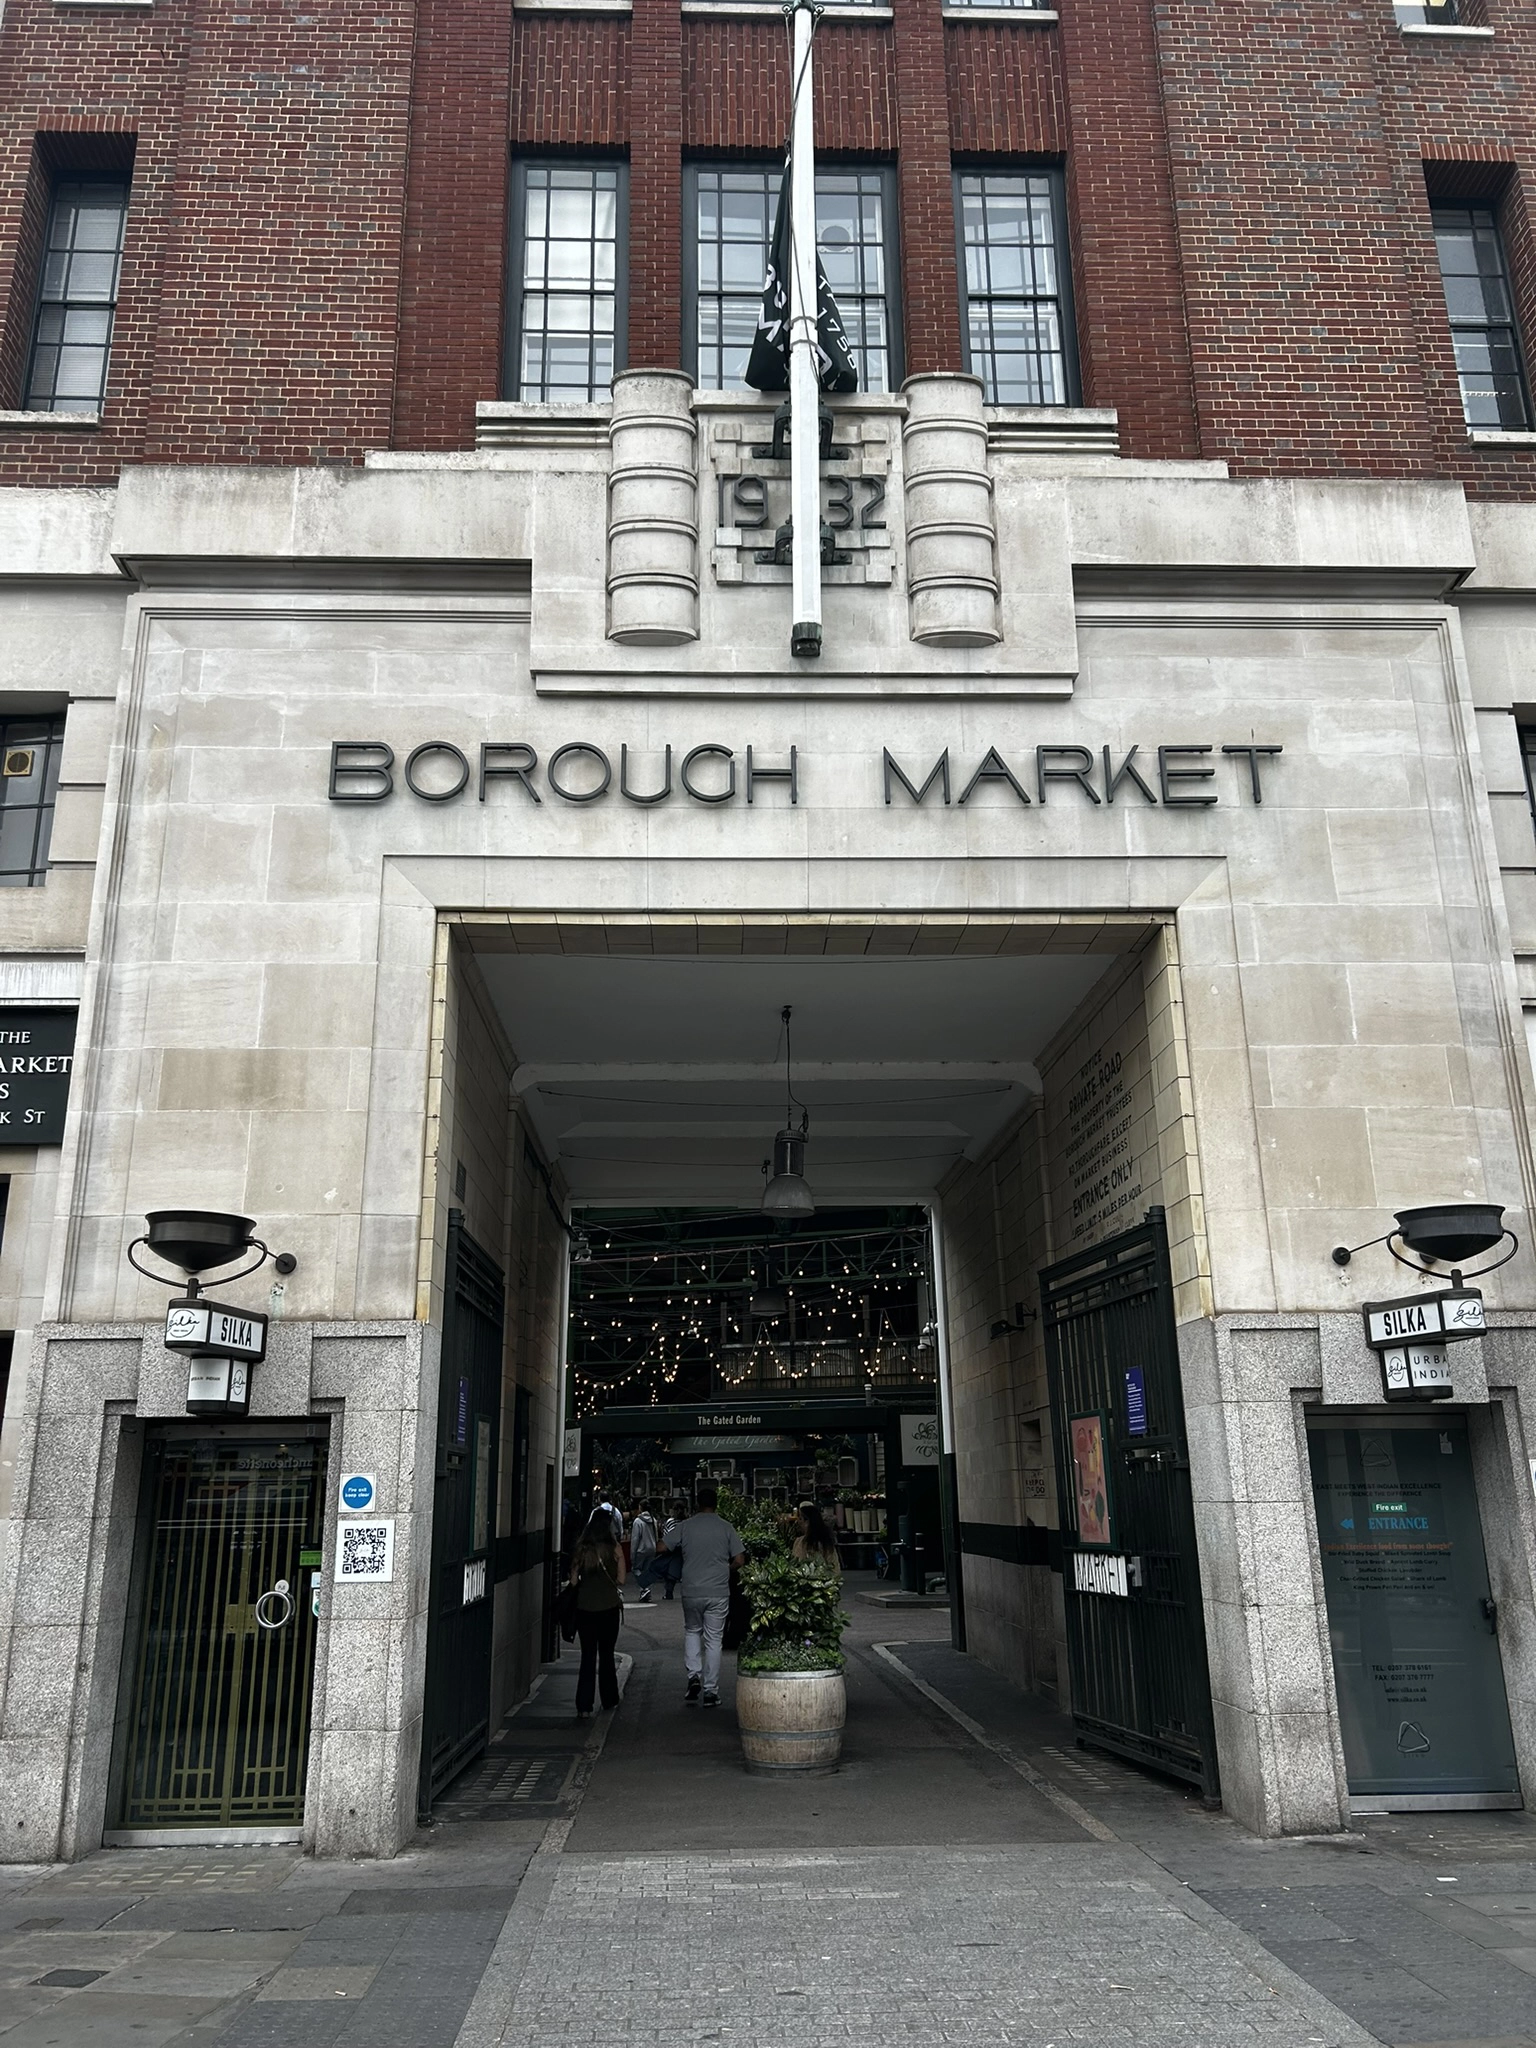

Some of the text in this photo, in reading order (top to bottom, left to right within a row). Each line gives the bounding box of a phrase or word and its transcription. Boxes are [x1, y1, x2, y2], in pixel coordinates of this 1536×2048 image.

[328, 741, 1283, 804] BOROUGH MARKET
[1069, 1052, 1122, 1119] PRIVATE ROAD
[1102, 1137, 1128, 1167] BUSINESS
[1073, 1156, 1133, 1218] ENTRANCE ONLY
[221, 1317, 252, 1347] SILKA
[1384, 1307, 1427, 1336] SILKA
[697, 1414, 761, 1425] The Gated Garden
[1368, 1517, 1429, 1530] ENTRANCE
